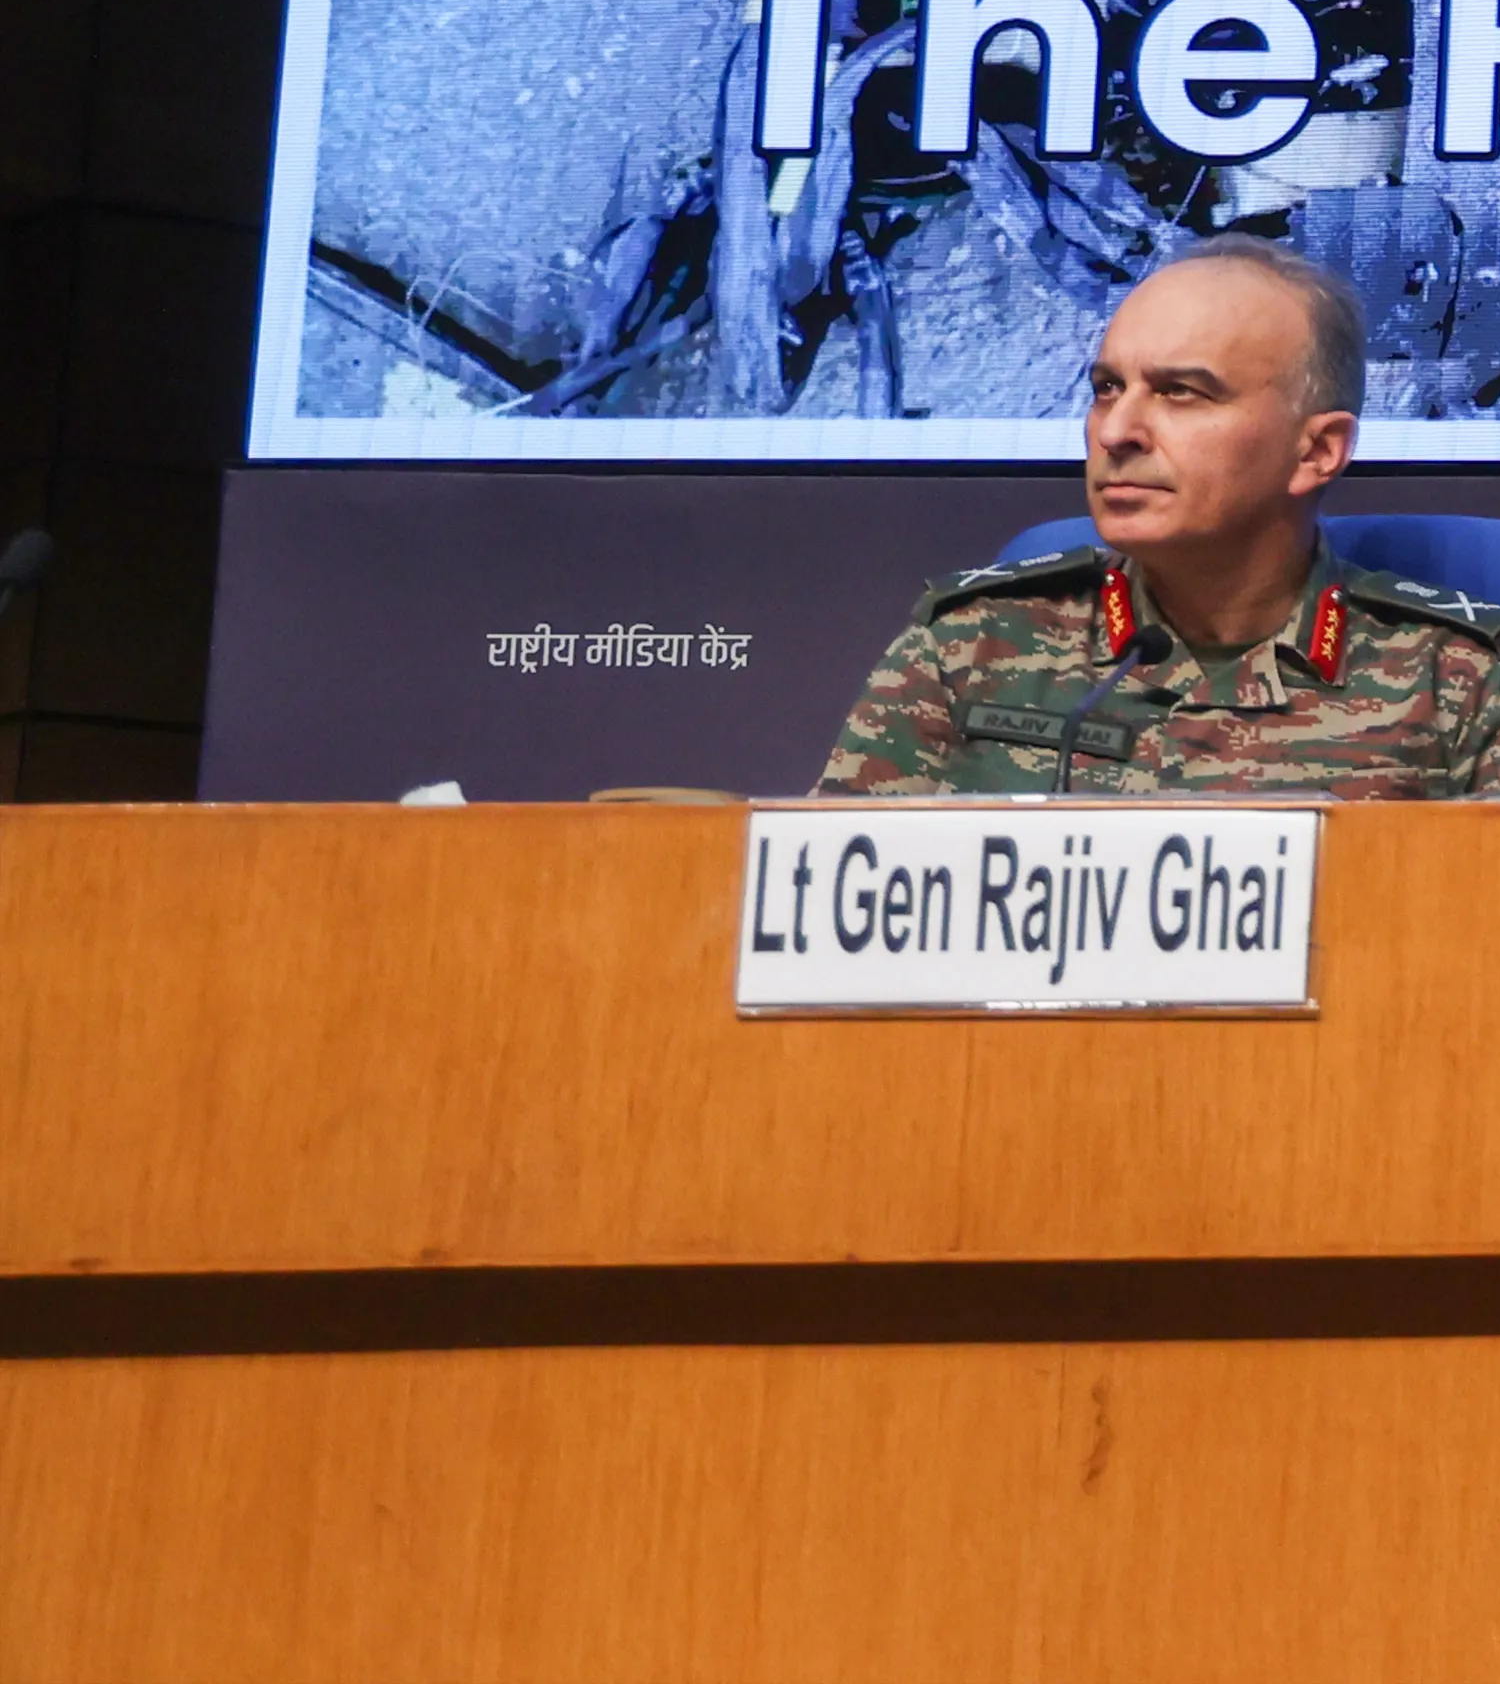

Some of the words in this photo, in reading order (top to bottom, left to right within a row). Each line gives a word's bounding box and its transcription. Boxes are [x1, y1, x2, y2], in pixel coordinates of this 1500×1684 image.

[487, 623, 580, 673] राष्ट्रीय
[585, 623, 695, 667] मीडिया
[699, 623, 753, 670] केंद्र
[984, 712, 1050, 734] RAJIV
[753, 837, 811, 954] Lt
[834, 835, 952, 954] Gen
[976, 836, 1128, 985] Rajiv
[1150, 835, 1286, 952] Ghai
